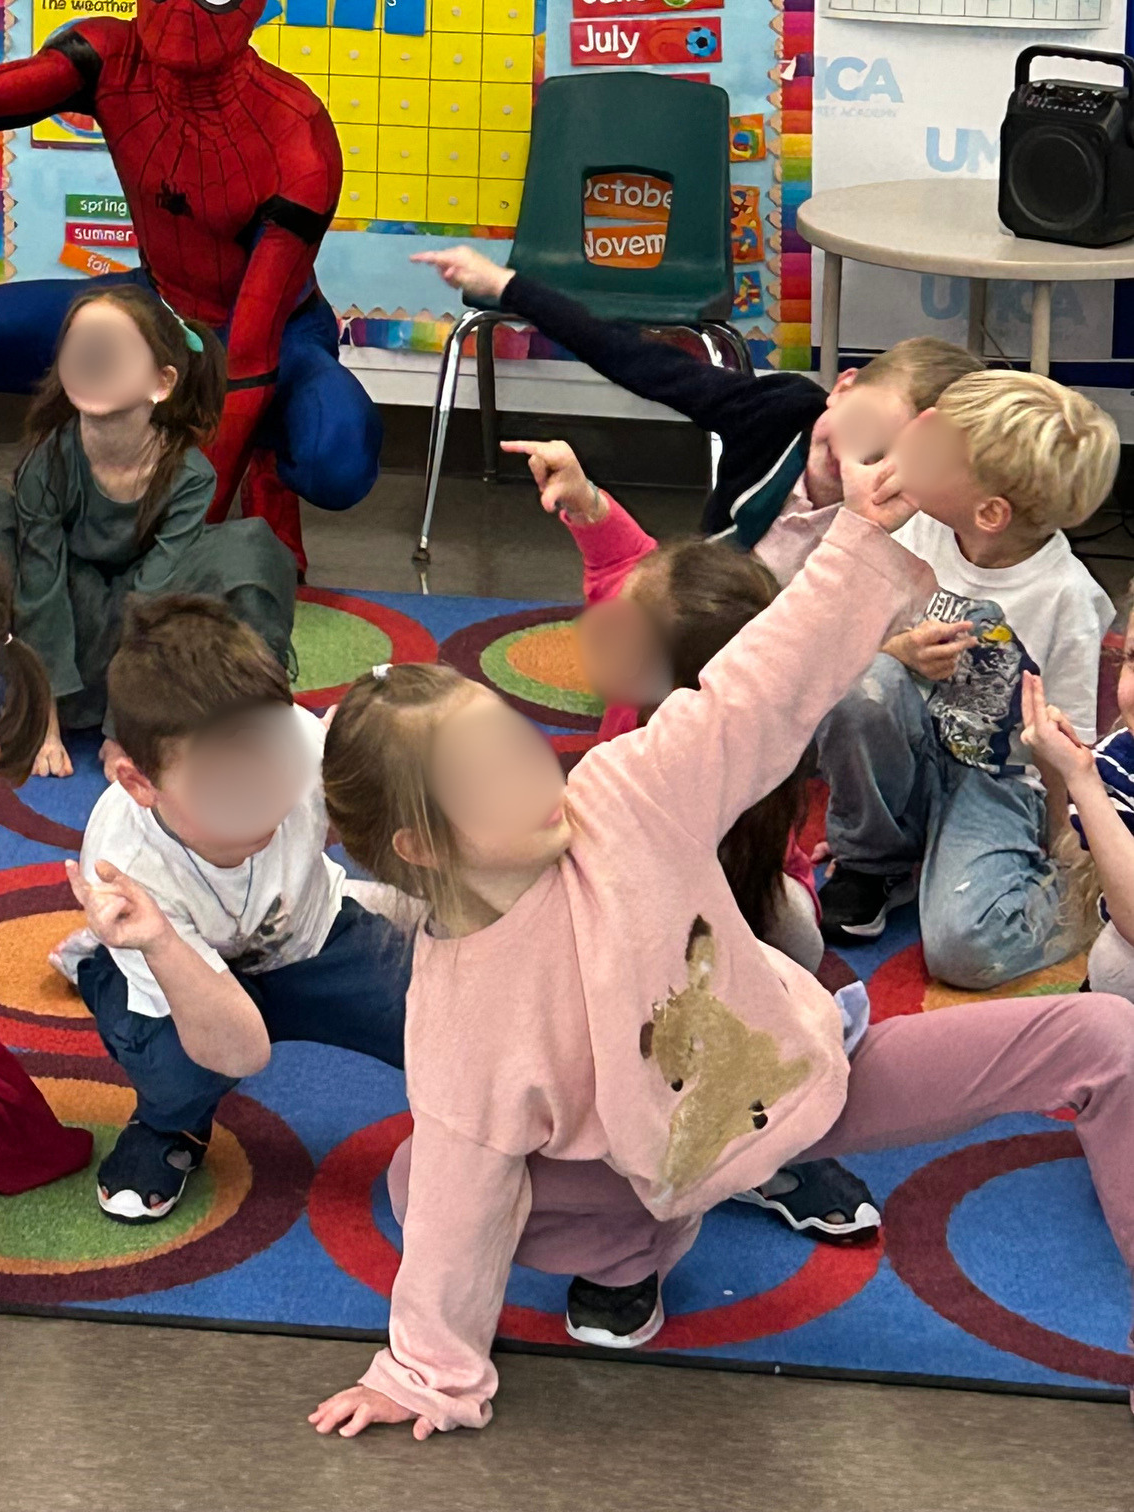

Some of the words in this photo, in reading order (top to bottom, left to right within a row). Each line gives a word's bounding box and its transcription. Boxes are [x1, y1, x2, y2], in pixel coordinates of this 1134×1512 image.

[579, 24, 640, 59] July
[79, 198, 128, 217] spring
[74, 227, 134, 242] summer
[86, 253, 111, 274] fall
